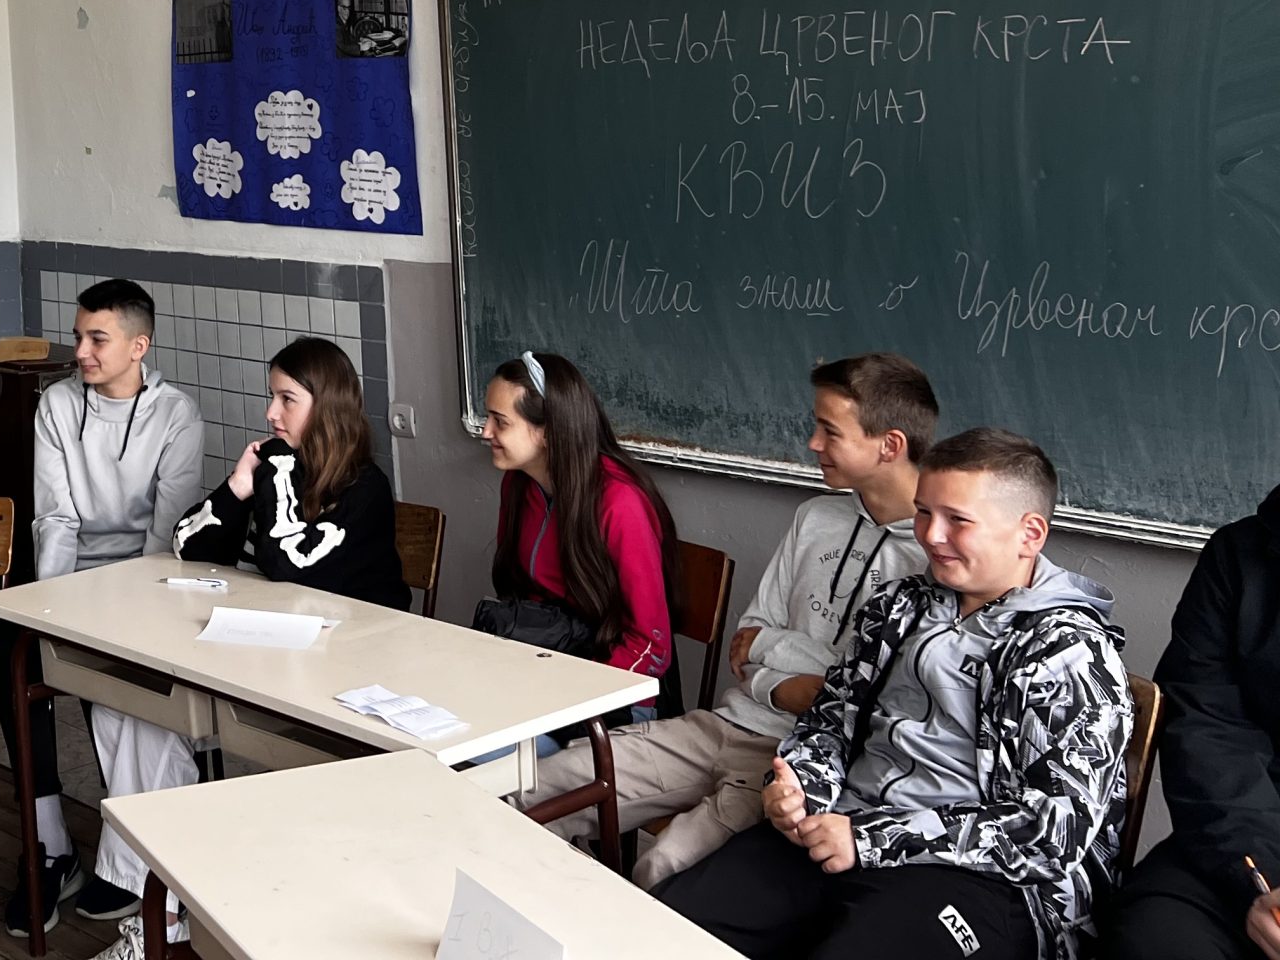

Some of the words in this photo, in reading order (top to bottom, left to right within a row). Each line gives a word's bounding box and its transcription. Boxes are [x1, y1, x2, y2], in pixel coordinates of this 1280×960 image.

[577, 10, 736, 77] НЕДЕЉА
[759, 10, 957, 76] ЦРВЕНОГ
[972, 14, 1131, 65] КРСТА
[676, 137, 887, 224] КВИЗ
[736, 274, 845, 317] знаш
[818, 548, 841, 565] TRUE
[869, 568, 882, 590] ARE
